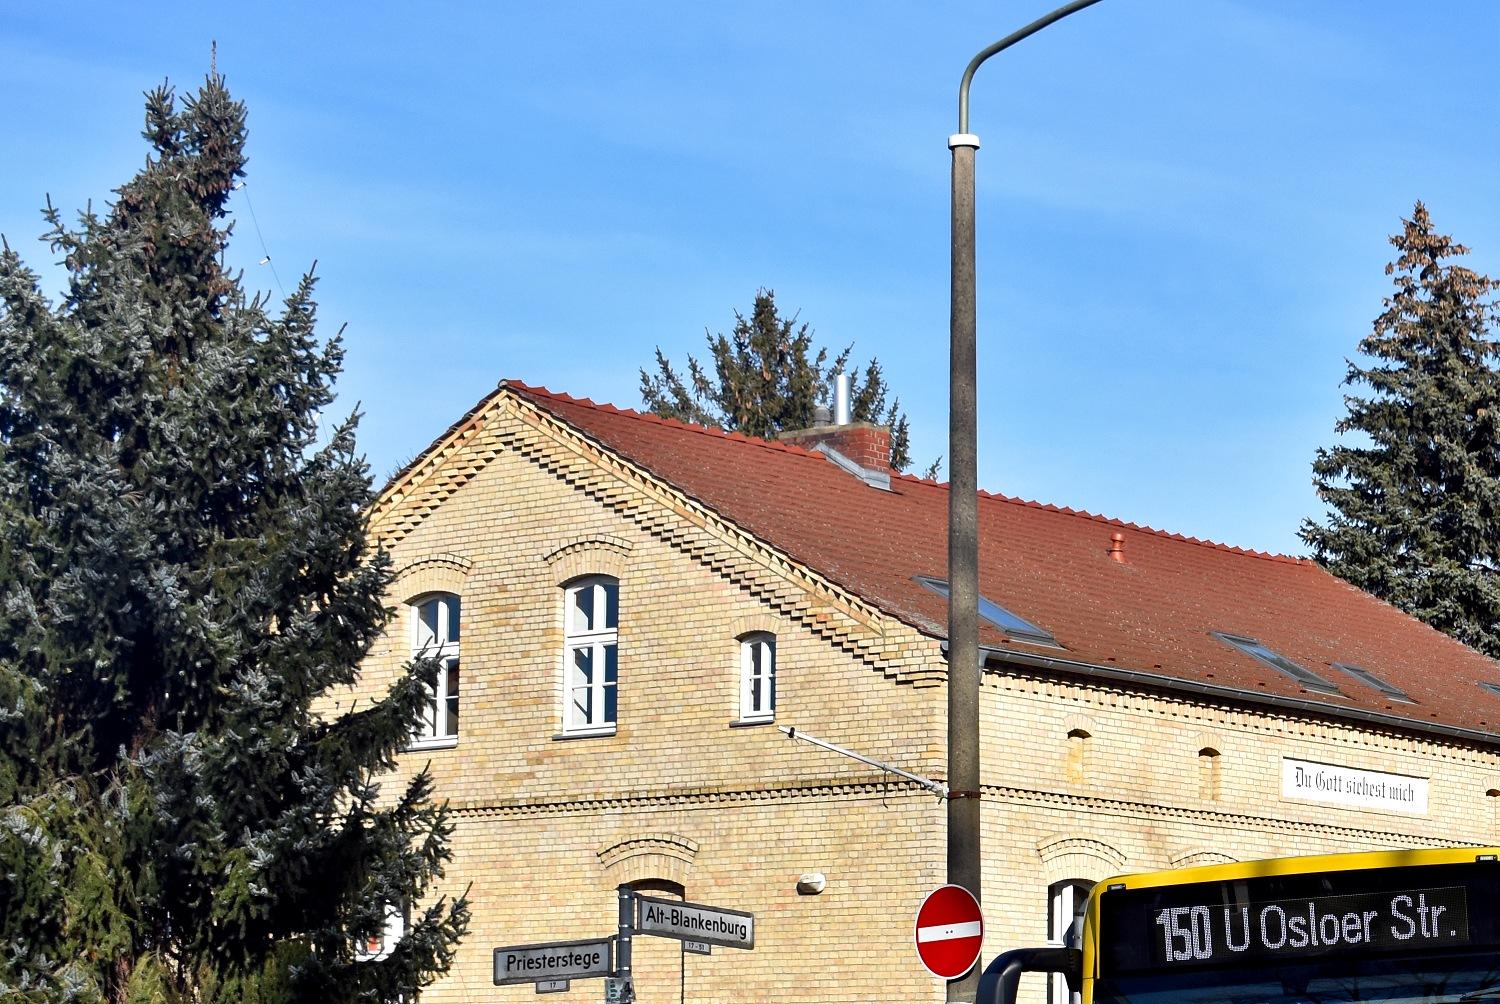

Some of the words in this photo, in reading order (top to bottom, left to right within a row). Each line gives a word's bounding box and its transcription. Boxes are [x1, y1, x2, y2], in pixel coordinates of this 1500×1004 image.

[1315, 770, 1342, 792] Gott
[1389, 783, 1414, 802] mich
[645, 905, 748, 940] Alt-Blankenburg
[1155, 905, 1213, 962] 150
[1224, 906, 1251, 953] U
[1260, 902, 1379, 949] Osloer
[1391, 893, 1457, 941] Str.
[506, 950, 601, 972] Priesterstege
